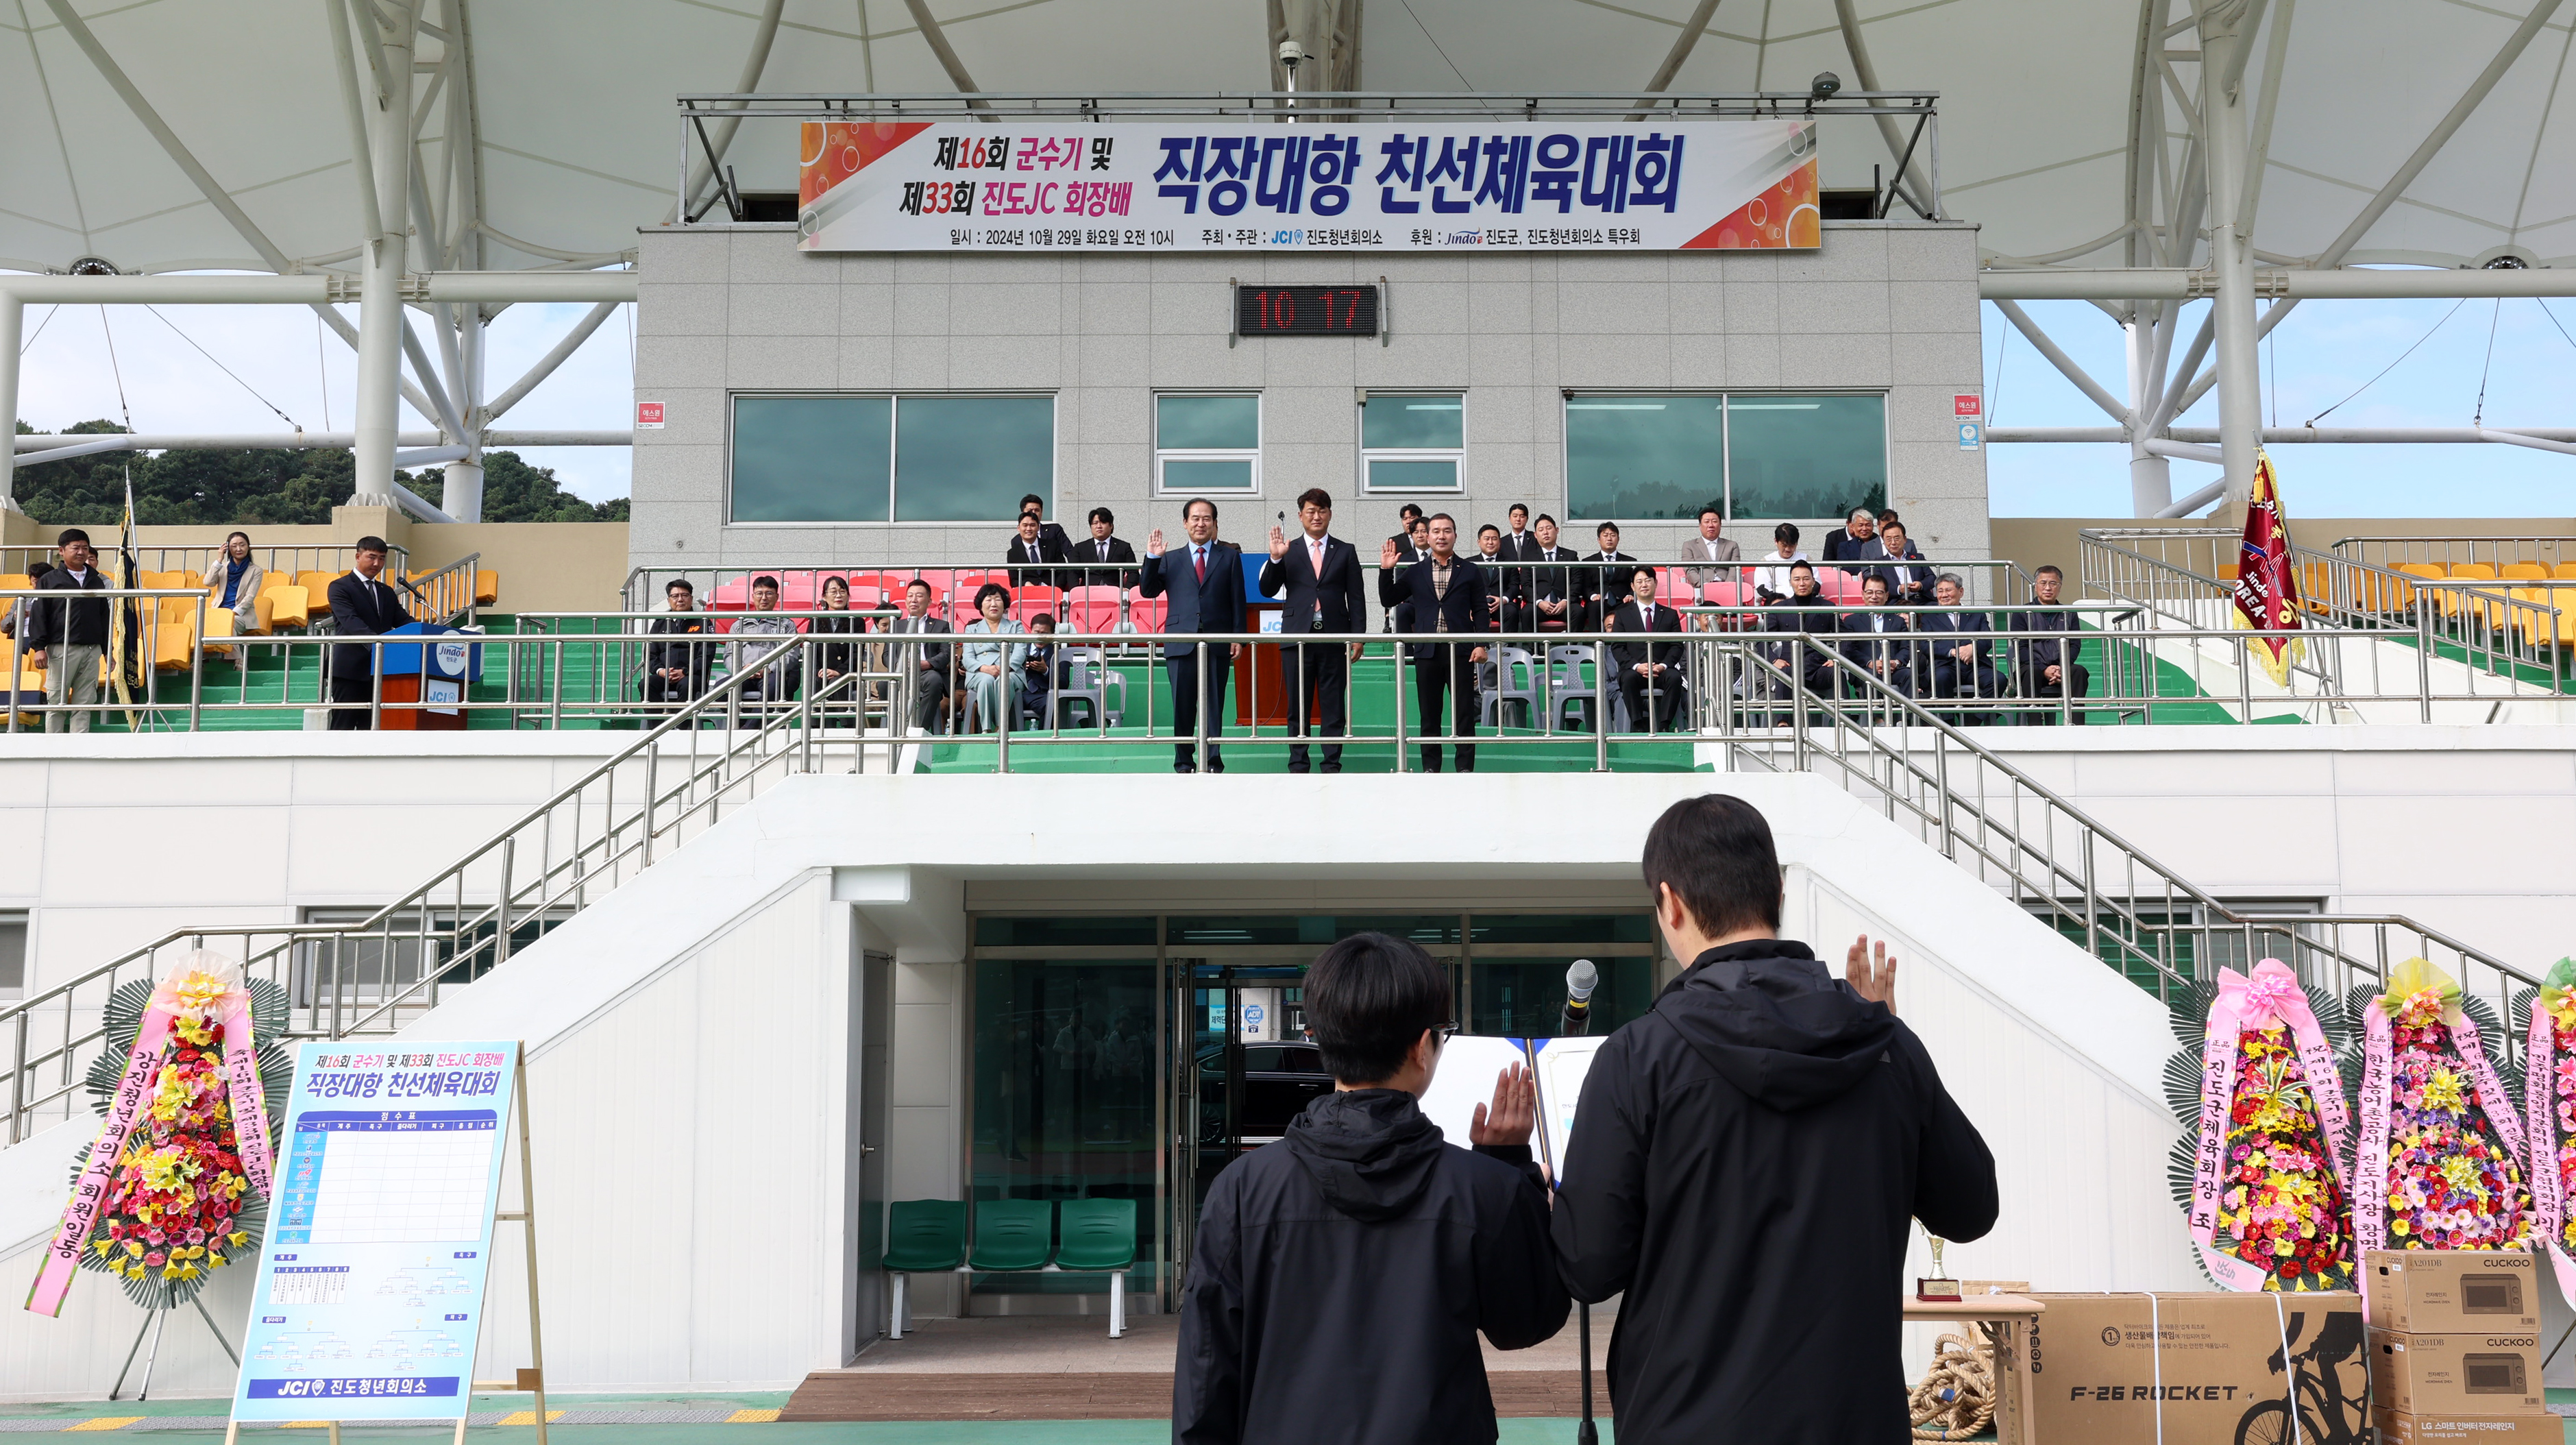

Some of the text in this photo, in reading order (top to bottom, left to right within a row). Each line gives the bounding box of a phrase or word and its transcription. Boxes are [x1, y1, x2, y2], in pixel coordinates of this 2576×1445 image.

[933, 136, 1113, 171] 제16회 군수기 및
[1153, 133, 1686, 217] 직장대항 친선체육대회
[899, 180, 1133, 217] 제33회 진도JC 회장배
[950, 229, 971, 245] 일시
[985, 229, 1024, 245] 2024년
[1029, 229, 1053, 245] 10월
[1057, 229, 1081, 245] 29일
[1086, 229, 1118, 245] 화요일
[1123, 229, 1145, 245] 오전
[1150, 229, 1174, 245] 10시
[1201, 229, 1223, 245] 주최
[1236, 229, 1258, 245] 주관
[1271, 230, 1292, 244] JCI
[1307, 229, 1383, 245] 진도청년회의소
[1411, 228, 1432, 245] 후원
[1445, 230, 1476, 245] Jindo
[1486, 228, 1522, 246] 진도군,
[1528, 228, 1604, 245] 진도청년회의소
[1608, 228, 1640, 245] 특우회
[1256, 291, 1360, 328] 10 17
[1262, 621, 1282, 632] JC
[2211, 1039, 2231, 1049] 正品
[2368, 1033, 2386, 1043] 正品
[2531, 1034, 2549, 1043] 正品
[315, 1052, 505, 1069] 제16회 군수기 및 제33회 진도JC 회장배
[306, 1070, 501, 1098] 직장대항 친선체육대회
[2360, 1053, 2387, 1146] 한국농어촌공사
[2198, 1059, 2227, 1200] 진도군체육회장
[54, 1050, 158, 1259] 강진청년회의소 회원일동
[2357, 1153, 2382, 1217] 진도지사장
[2191, 1213, 2212, 1230] 조
[2357, 1223, 2382, 1259] 황명
[2412, 1259, 2442, 1267] A201DB
[2483, 1259, 2530, 1267] CUCKOO
[278, 1379, 427, 1396] JCI 진도청년회의소
[2070, 1385, 2238, 1401] F-26 ROCKET
[2457, 1422, 2478, 1431] 인버터
[2479, 1422, 2515, 1431] 전자레인지
